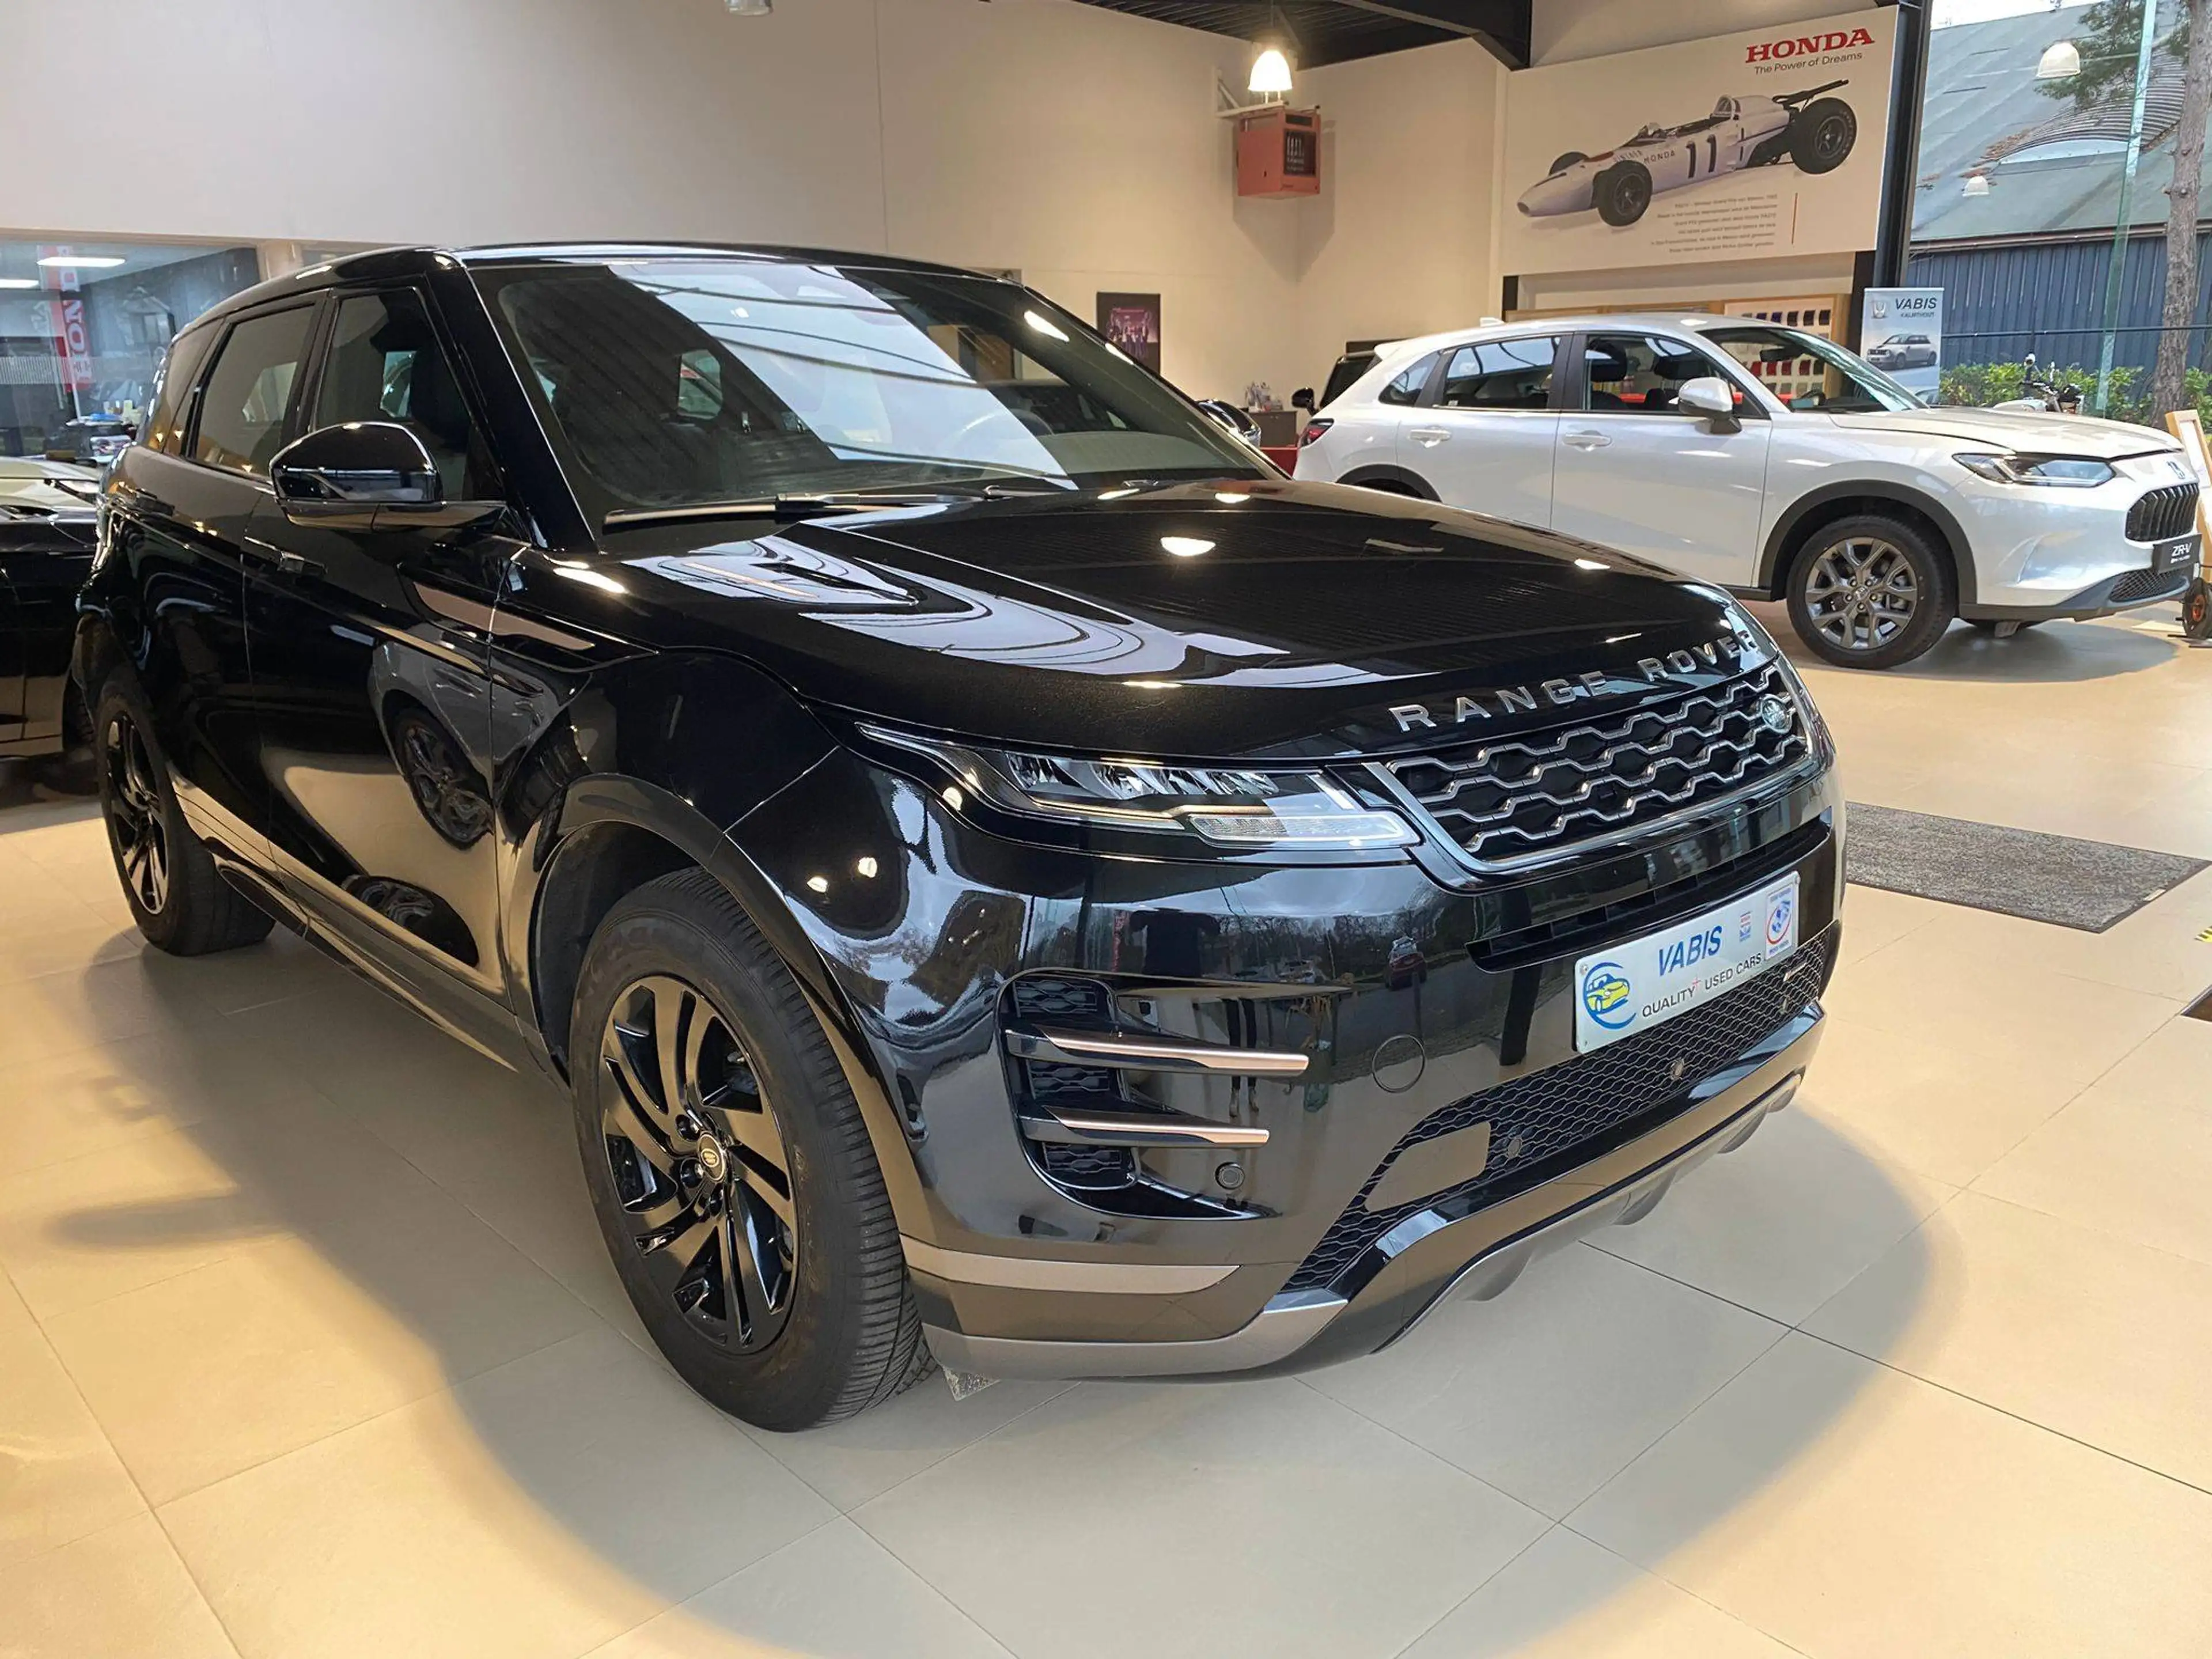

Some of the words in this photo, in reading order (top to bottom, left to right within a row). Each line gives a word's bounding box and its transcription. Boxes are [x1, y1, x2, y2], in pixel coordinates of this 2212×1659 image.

[1745, 28, 1875, 63] HONDA
[1755, 65, 1772, 74] The
[1774, 61, 1805, 72] Power
[1808, 58, 1818, 66] of
[1822, 52, 1862, 65] Dreams
[1643, 150, 1675, 164] HONDA
[1685, 134, 1717, 179] 11
[1895, 297, 1937, 309] VABIS
[1388, 671, 1608, 733] RANGE
[1637, 630, 1759, 682] ROVER
[1658, 925, 1723, 977] VABIS
[1705, 968, 1733, 990] USED
[1736, 952, 1762, 975] CARS
